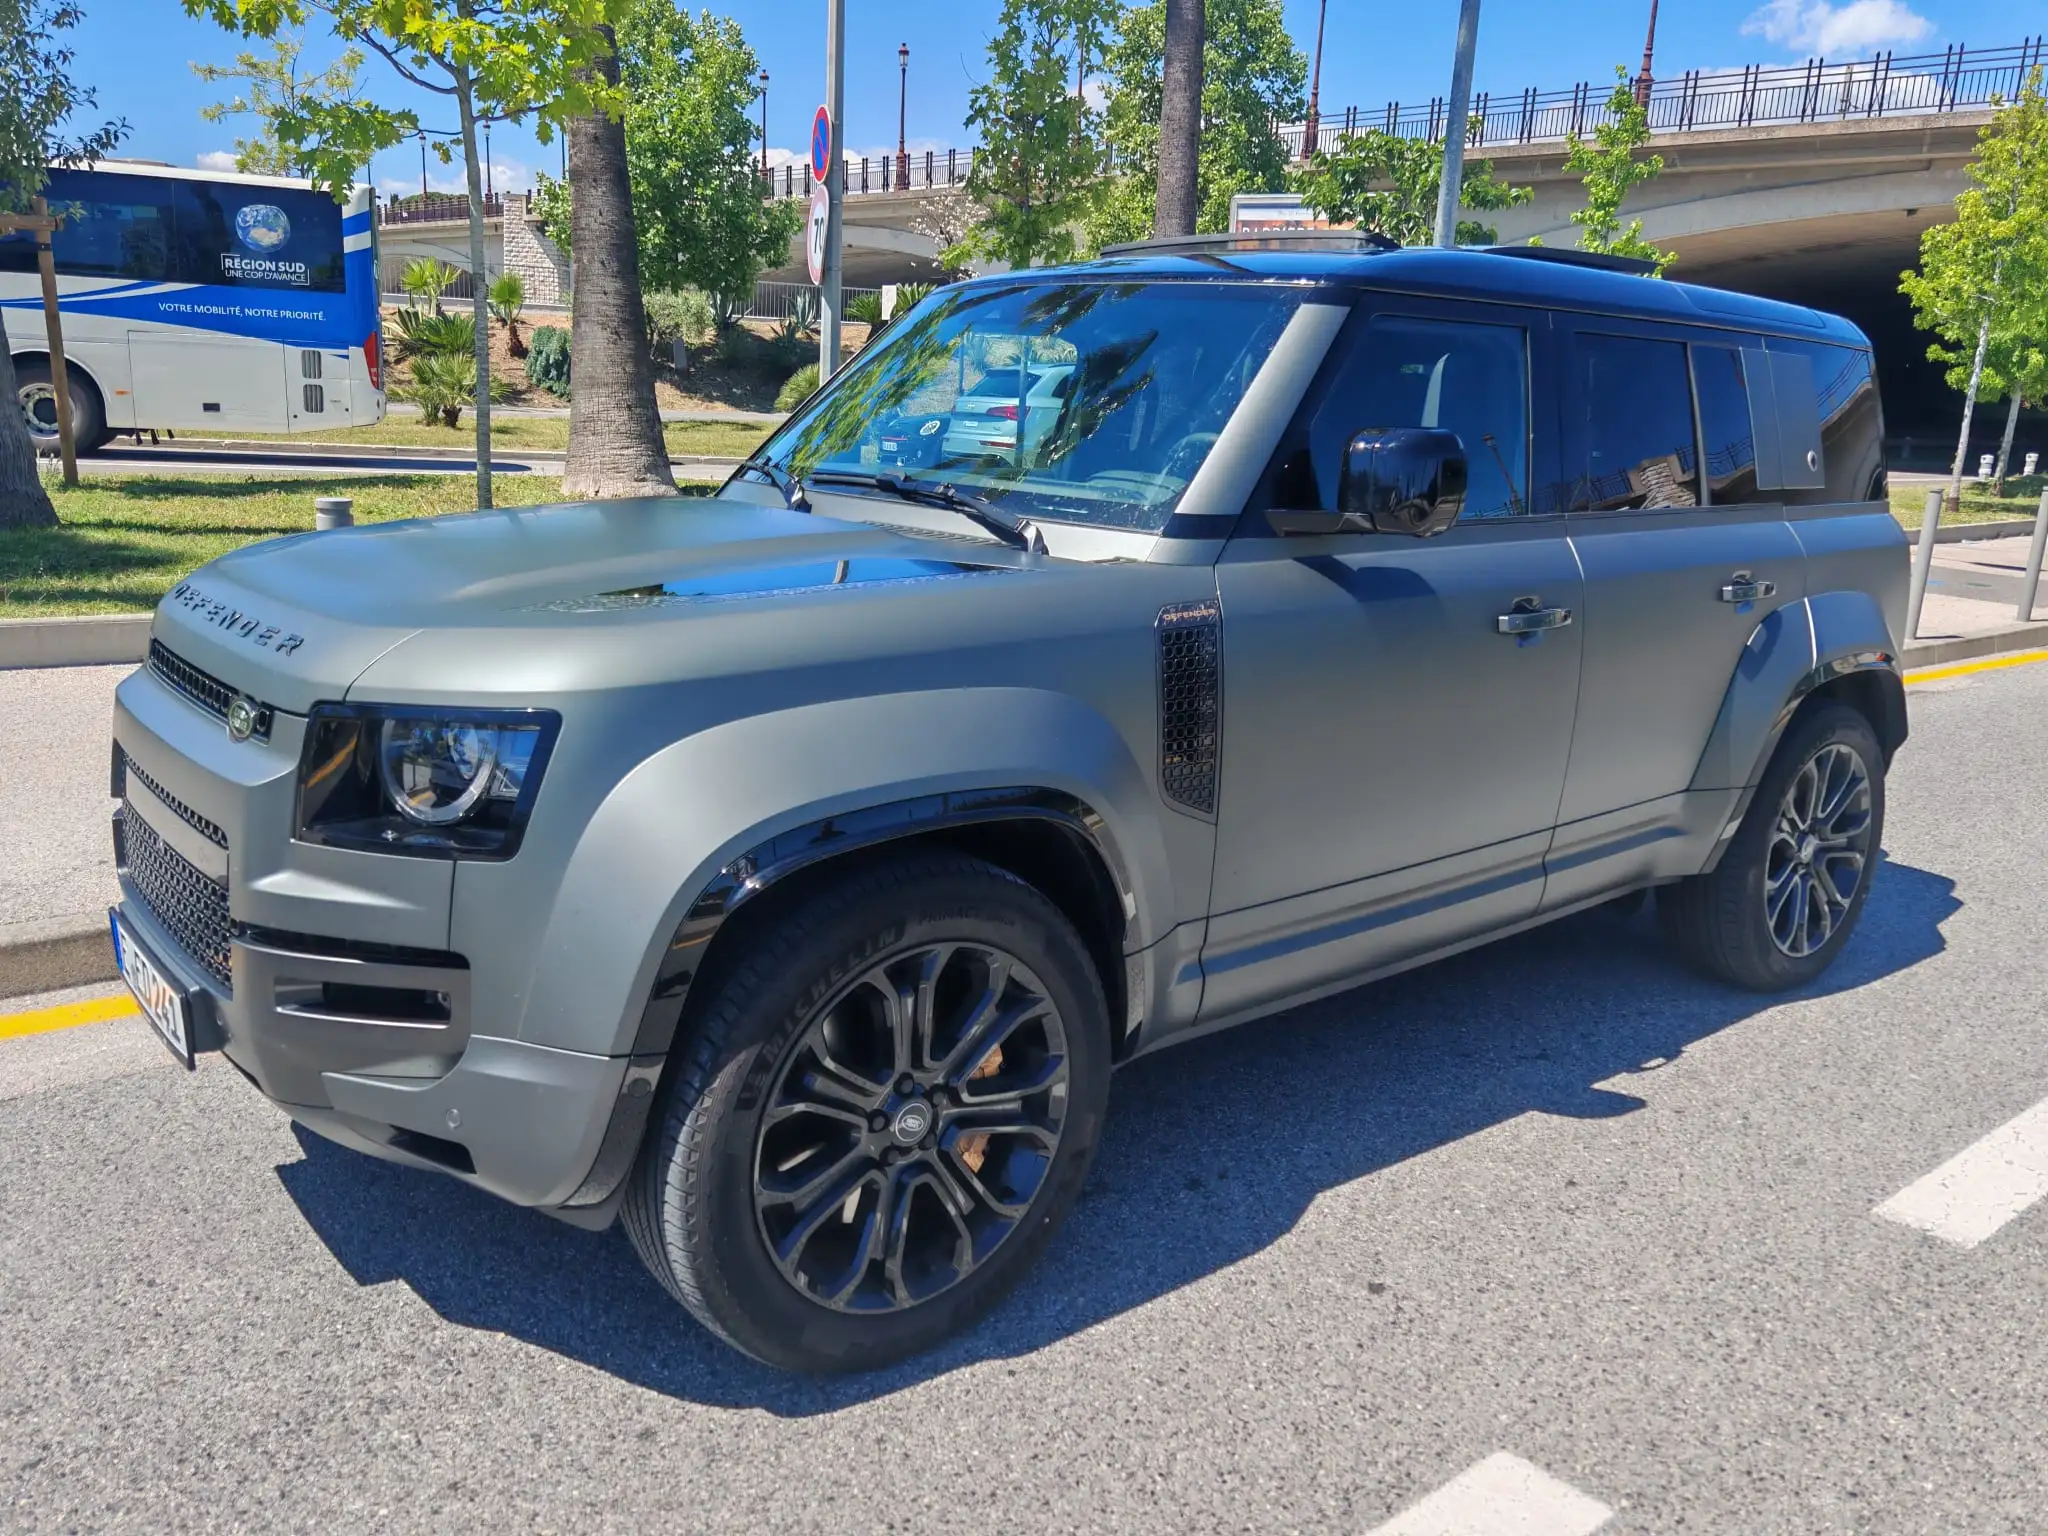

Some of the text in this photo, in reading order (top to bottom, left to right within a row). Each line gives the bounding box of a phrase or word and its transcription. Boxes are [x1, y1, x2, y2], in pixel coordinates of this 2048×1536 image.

[814, 216, 825, 254] 70
[225, 269, 306, 282] UNE COP D'AVANCE
[278, 261, 306, 273] SUD
[158, 302, 327, 321] VOTRE MOBILITÉ, NOTRE PRIORITÉ.
[174, 583, 304, 656] DEFENDER
[1163, 608, 1217, 622] DEFENDER
[763, 927, 897, 1064] MICHELIN
